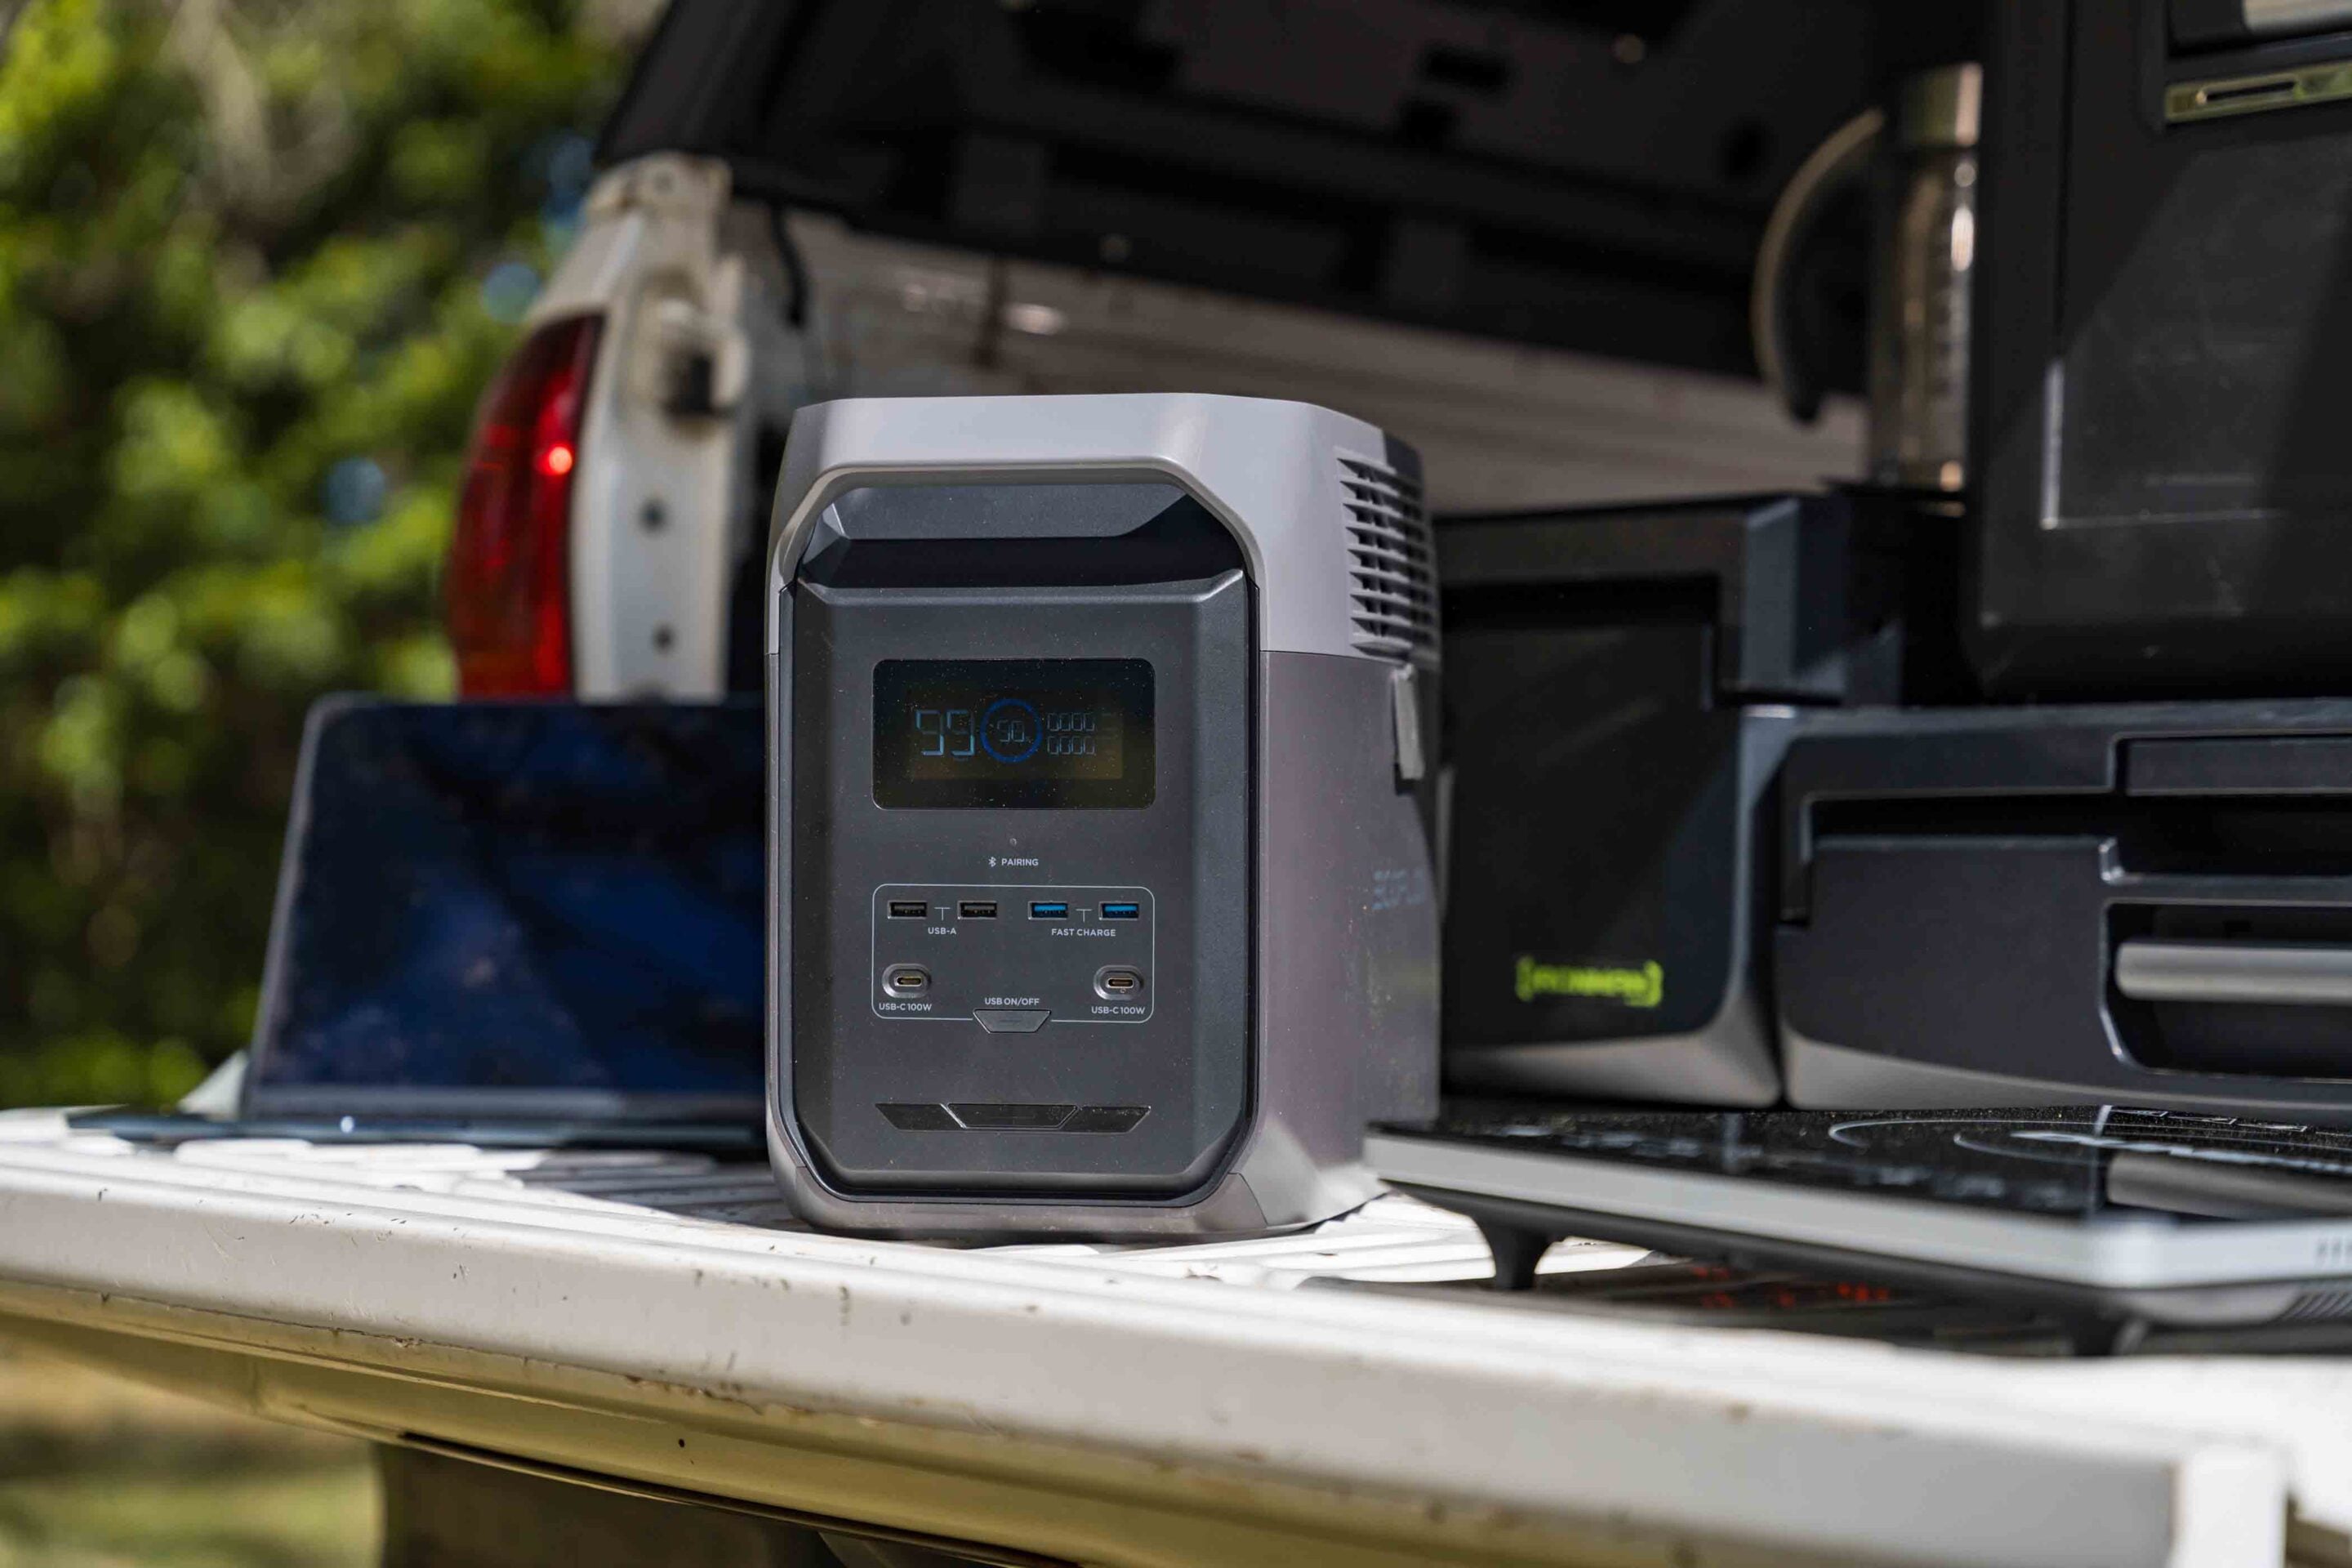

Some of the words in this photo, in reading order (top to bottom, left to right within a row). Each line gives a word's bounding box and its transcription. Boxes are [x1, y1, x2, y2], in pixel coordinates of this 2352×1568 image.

[915, 709, 976, 756] 99
[1001, 858, 1039, 866] PAIRING
[928, 927, 957, 935] USB-A
[1051, 928, 1074, 936] FAST
[1076, 929, 1116, 937] CHARGE
[984, 997, 1003, 1005] USB
[1004, 997, 1040, 1006] ON/OFF
[879, 1003, 906, 1011] USB-C
[907, 1003, 932, 1011] 100W
[1091, 1006, 1119, 1014] USB-C
[1120, 1006, 1145, 1014] 100W
